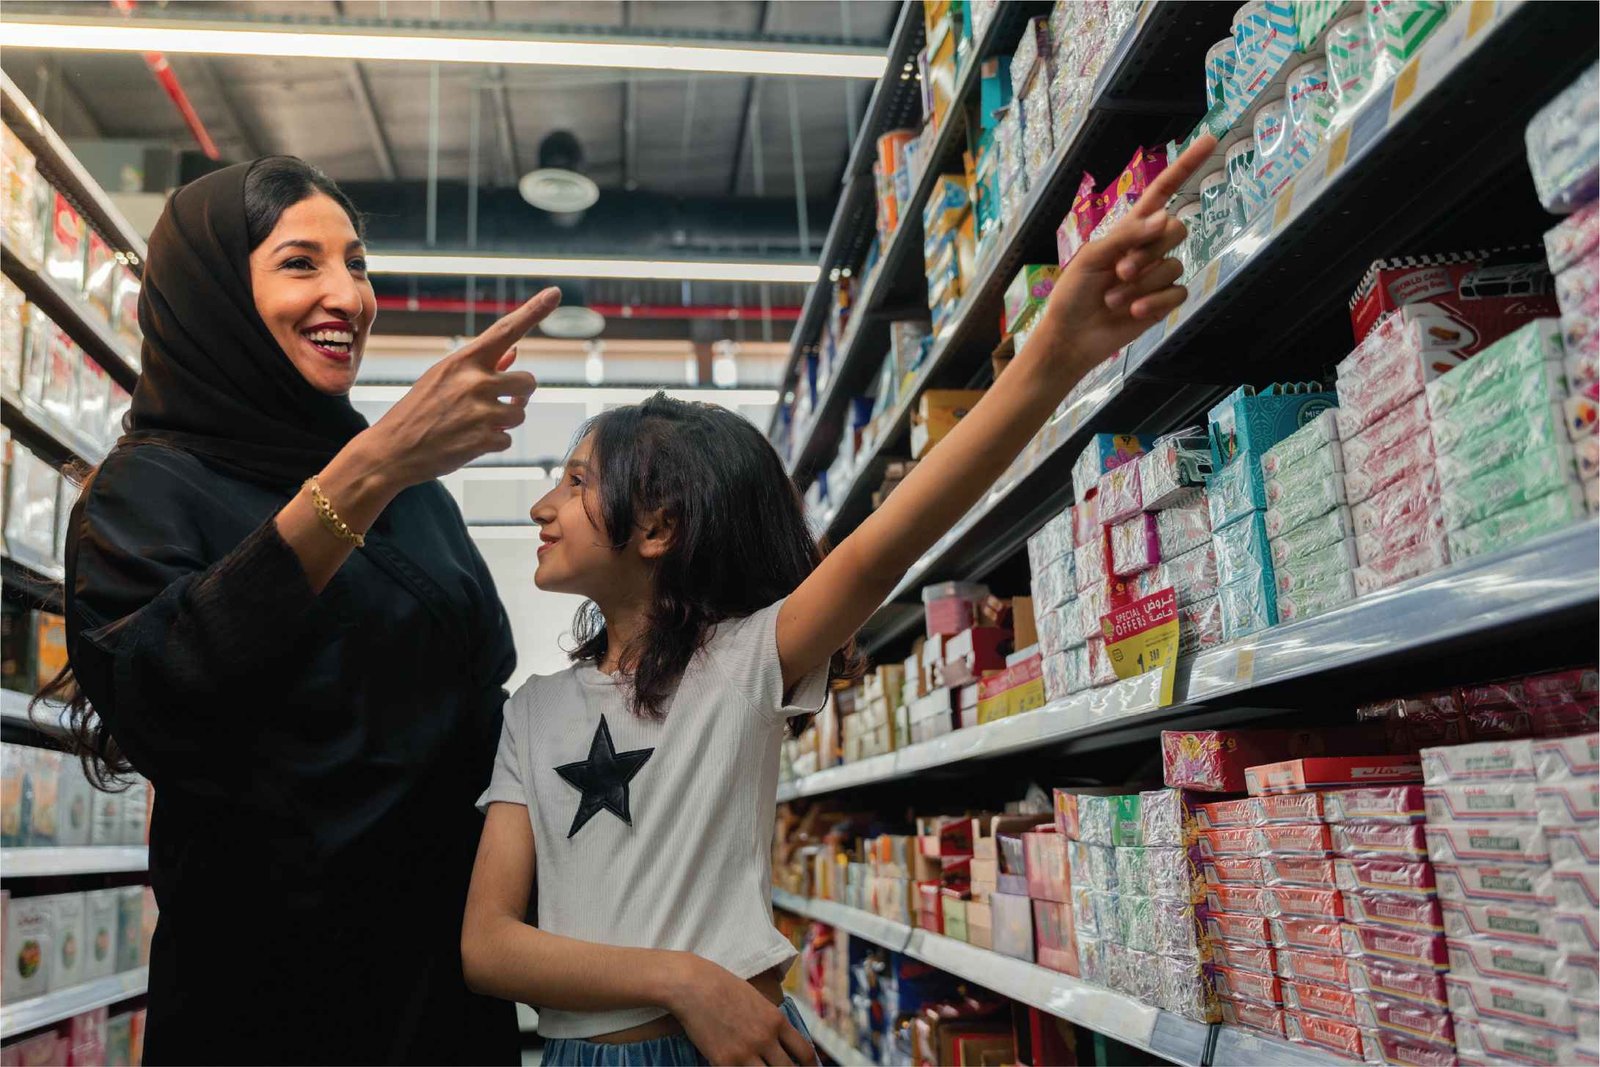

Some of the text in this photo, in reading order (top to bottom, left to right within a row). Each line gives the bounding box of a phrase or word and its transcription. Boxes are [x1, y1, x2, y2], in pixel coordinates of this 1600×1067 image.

[1144, 594, 1174, 613] عروض
[1116, 608, 1141, 623] SPECIAL
[1149, 608, 1173, 622] خاصة
[1116, 615, 1147, 636] OFFERS
